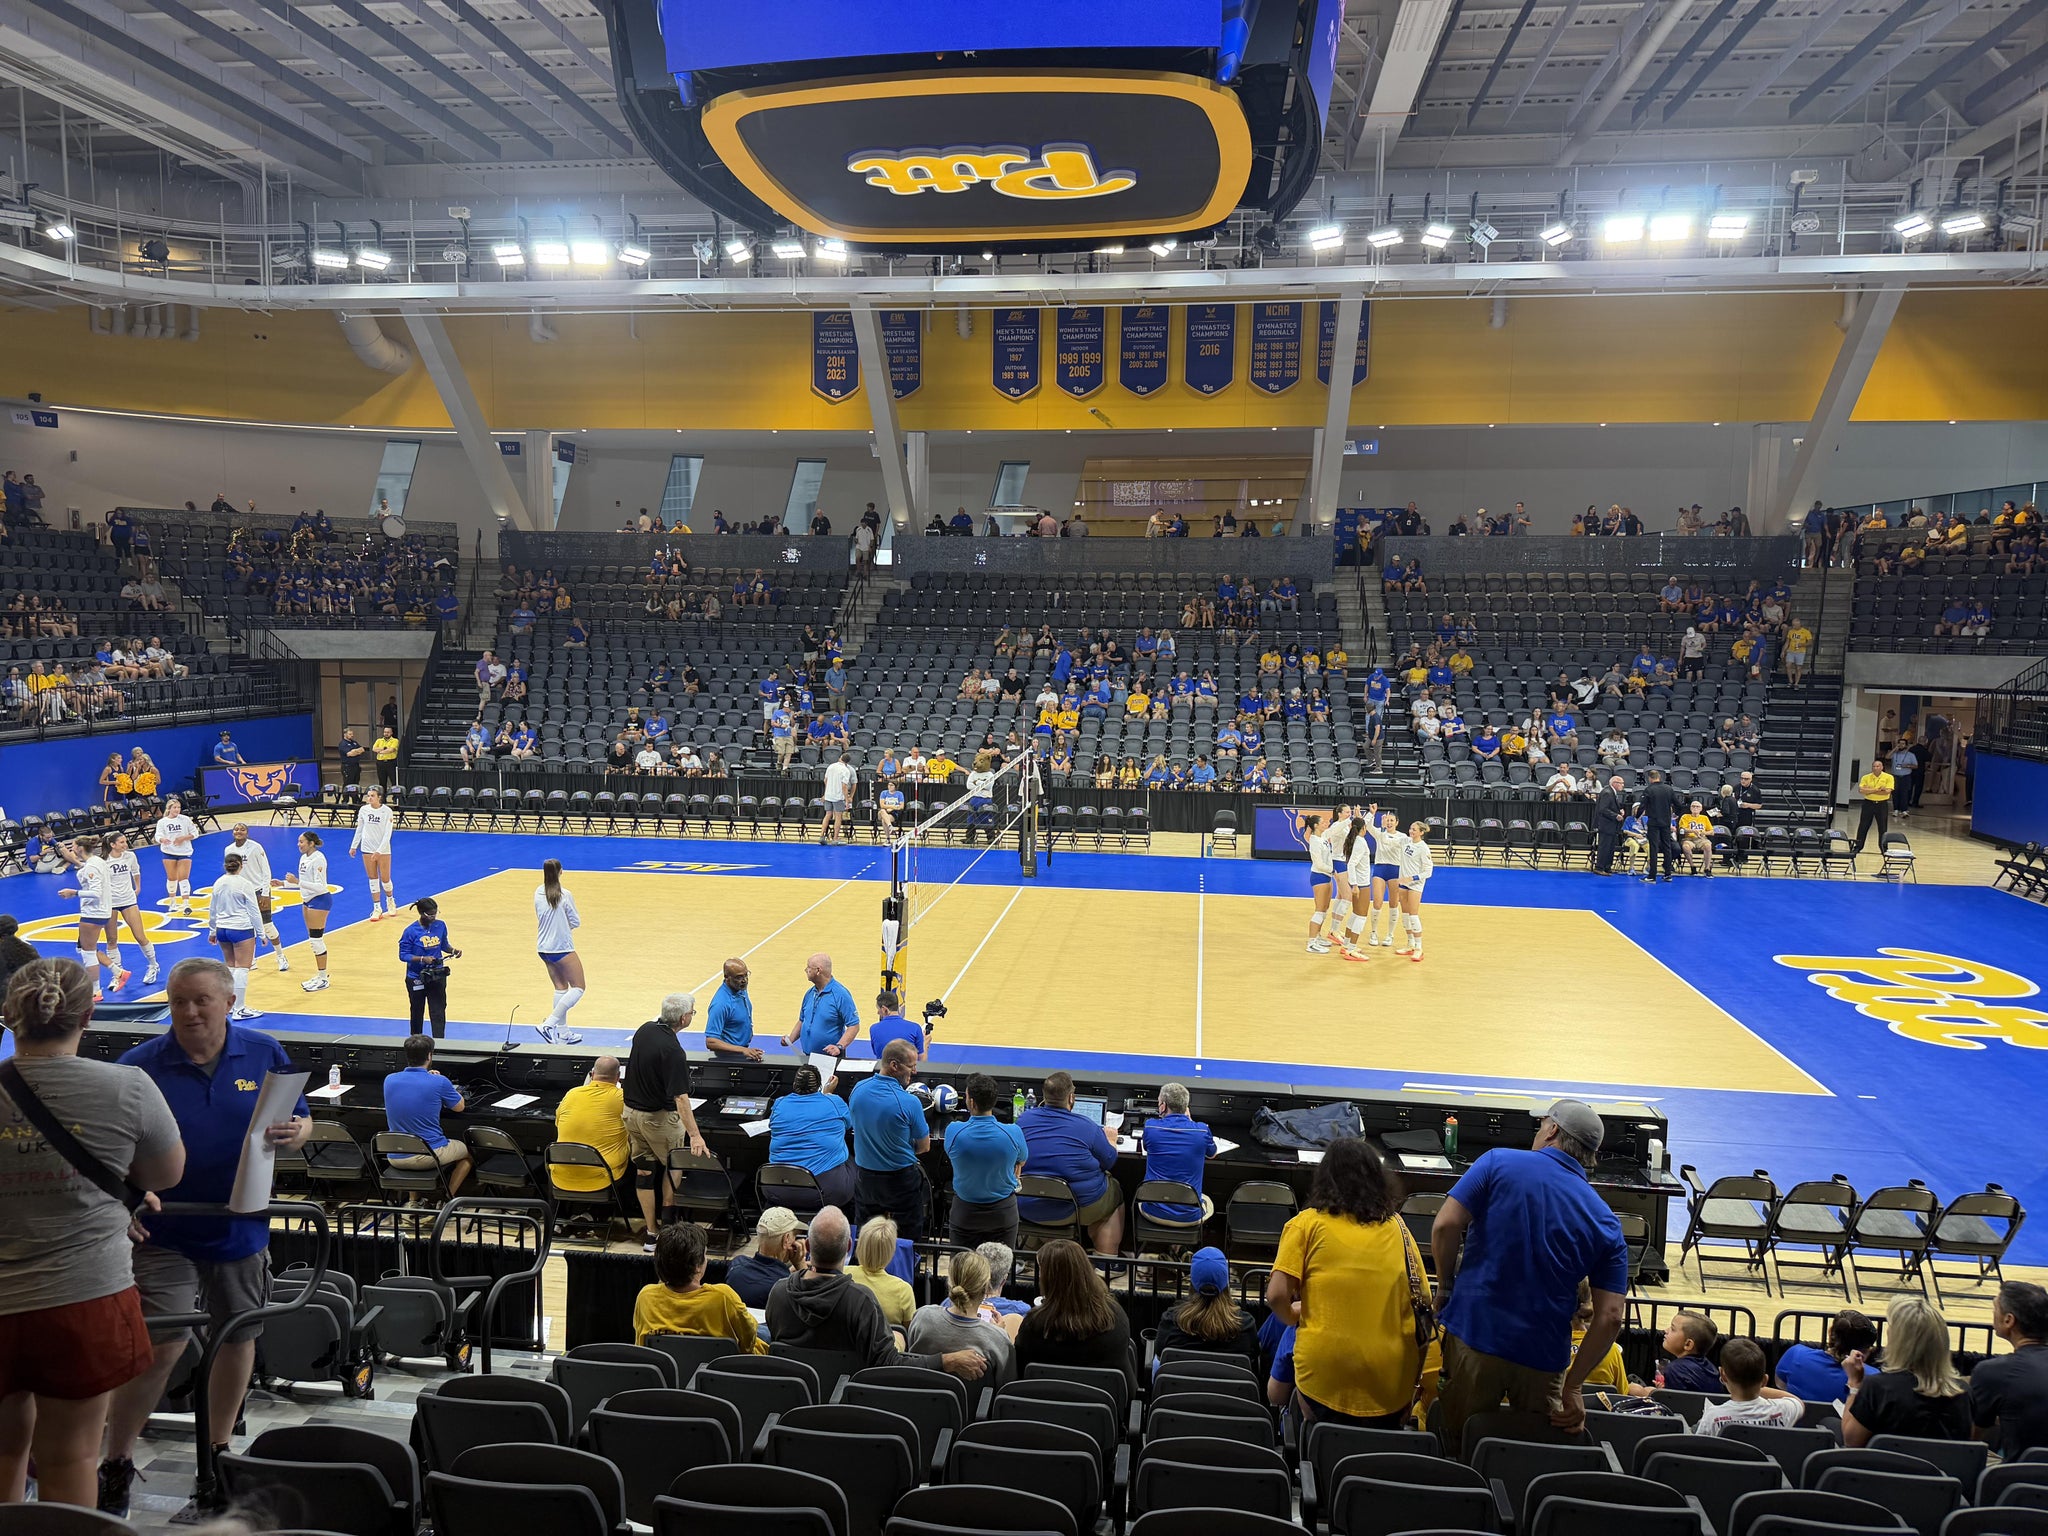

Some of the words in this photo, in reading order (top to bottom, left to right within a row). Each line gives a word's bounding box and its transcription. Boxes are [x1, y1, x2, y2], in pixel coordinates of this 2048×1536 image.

[847, 143, 1137, 200] Pitt
[1266, 304, 1290, 316] NCAA
[821, 314, 850, 324] ACC
[1257, 322, 1297, 330] GYMNASTICS
[1200, 344, 1220, 356] 2016
[827, 356, 846, 367] 2014
[1060, 353, 1078, 364] 1989
[1082, 353, 1101, 364] 1999
[827, 369, 847, 380] 2023
[1069, 365, 1090, 377] 2005
[831, 388, 841, 396] Pitt
[16, 413, 29, 421] 105
[368, 813, 381, 823] Pitt
[166, 823, 182, 832] Pitt
[1689, 821, 1705, 830] Pitt
[110, 863, 128, 873] Pitt
[419, 935, 441, 948] Pitt
[234, 1078, 259, 1091] Pitt
[18, 1141, 47, 1154] UK
